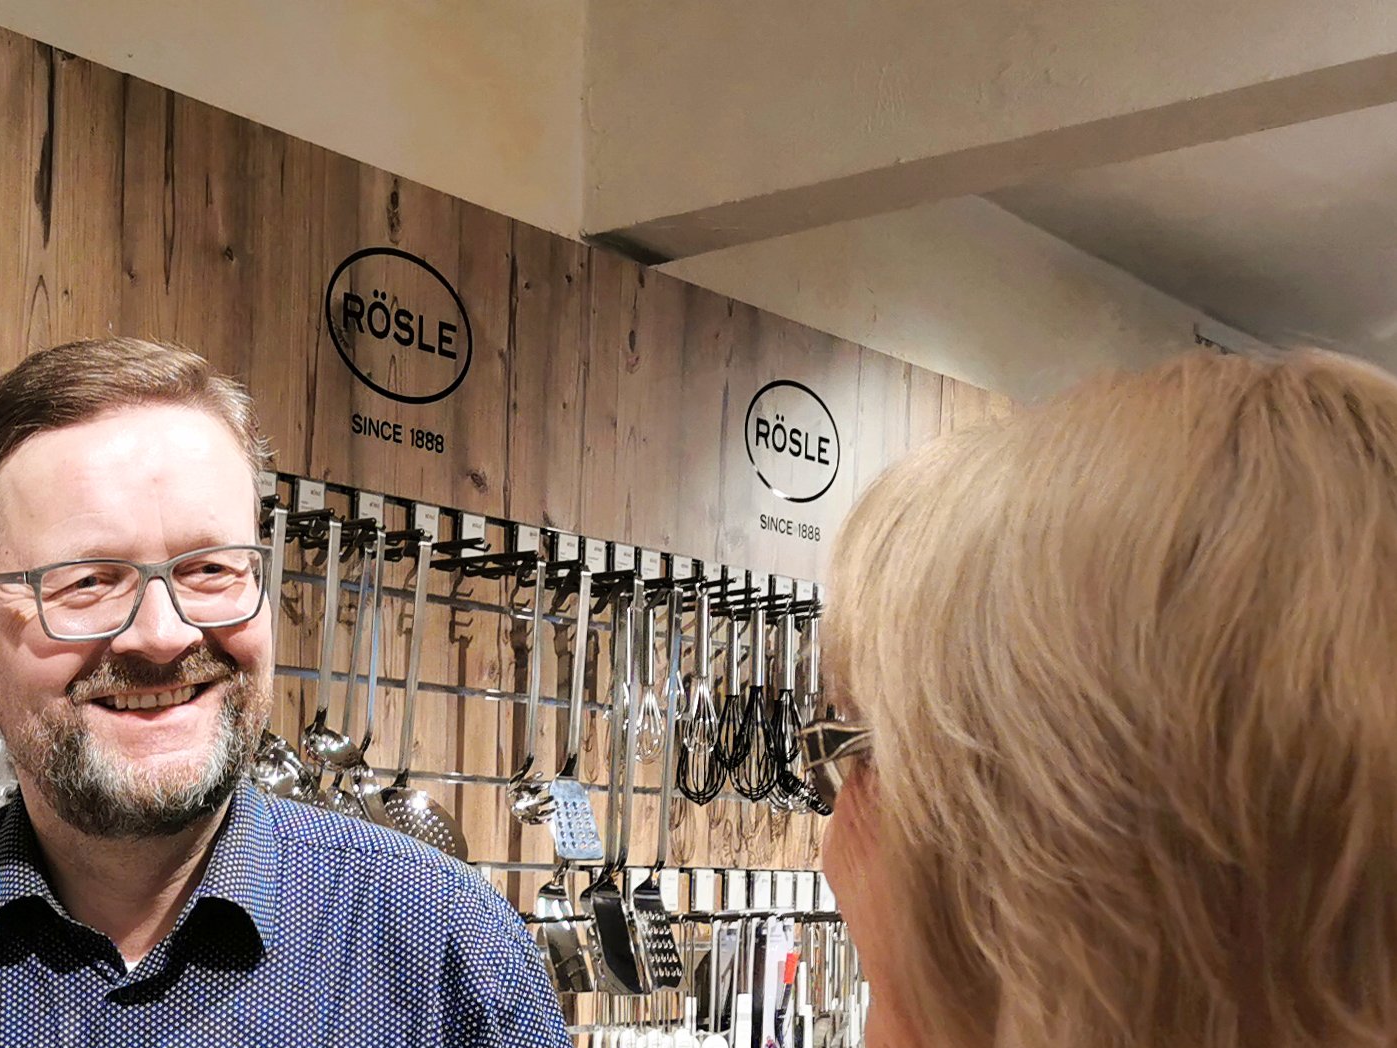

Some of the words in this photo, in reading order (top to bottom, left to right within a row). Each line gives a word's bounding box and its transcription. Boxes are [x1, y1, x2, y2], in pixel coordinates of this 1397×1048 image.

[342, 288, 458, 360] RÖSLE
[351, 412, 403, 444] SINCE
[409, 427, 445, 454] 1888
[755, 413, 830, 466] RÖSLE
[759, 513, 793, 536] SINCE
[798, 523, 821, 542] 1888
